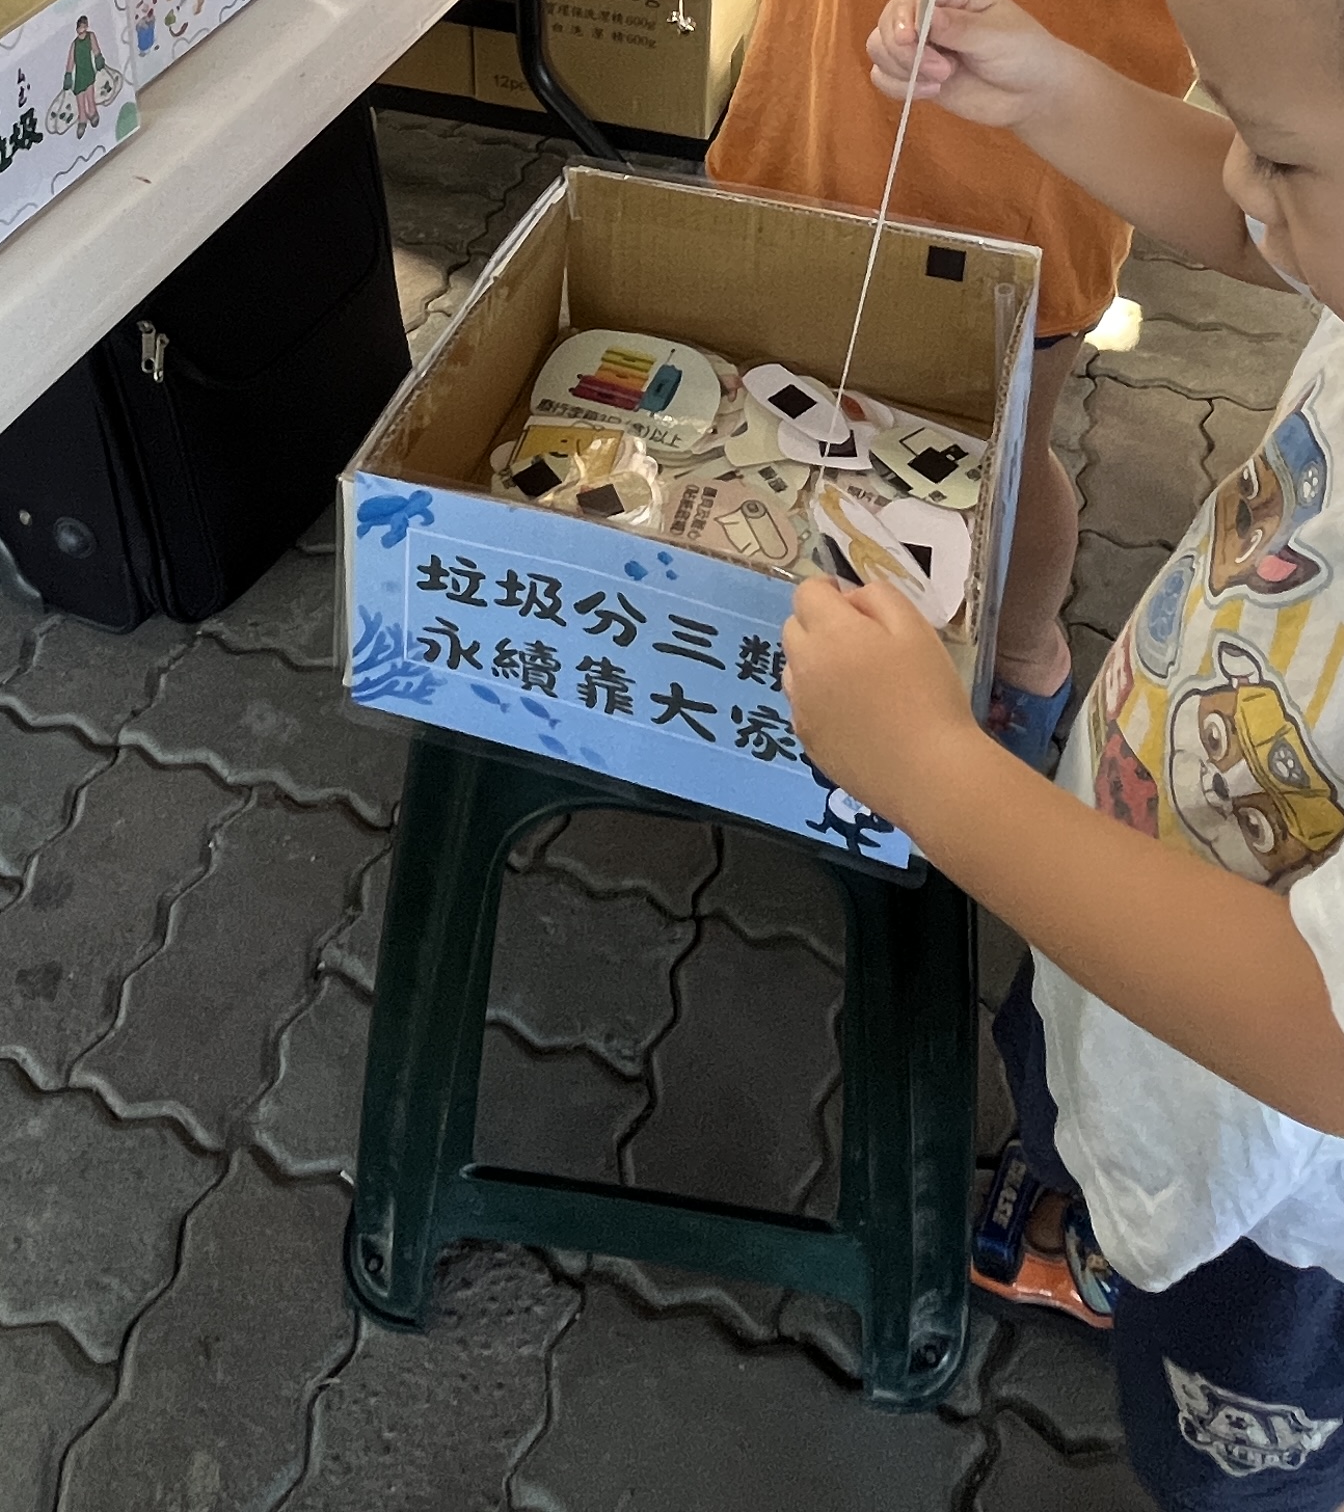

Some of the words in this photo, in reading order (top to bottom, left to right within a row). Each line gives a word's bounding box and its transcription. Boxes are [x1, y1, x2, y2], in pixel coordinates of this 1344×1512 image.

[416, 554, 787, 692] 垃圾分三類
[416, 616, 800, 763] 永續靠大家
